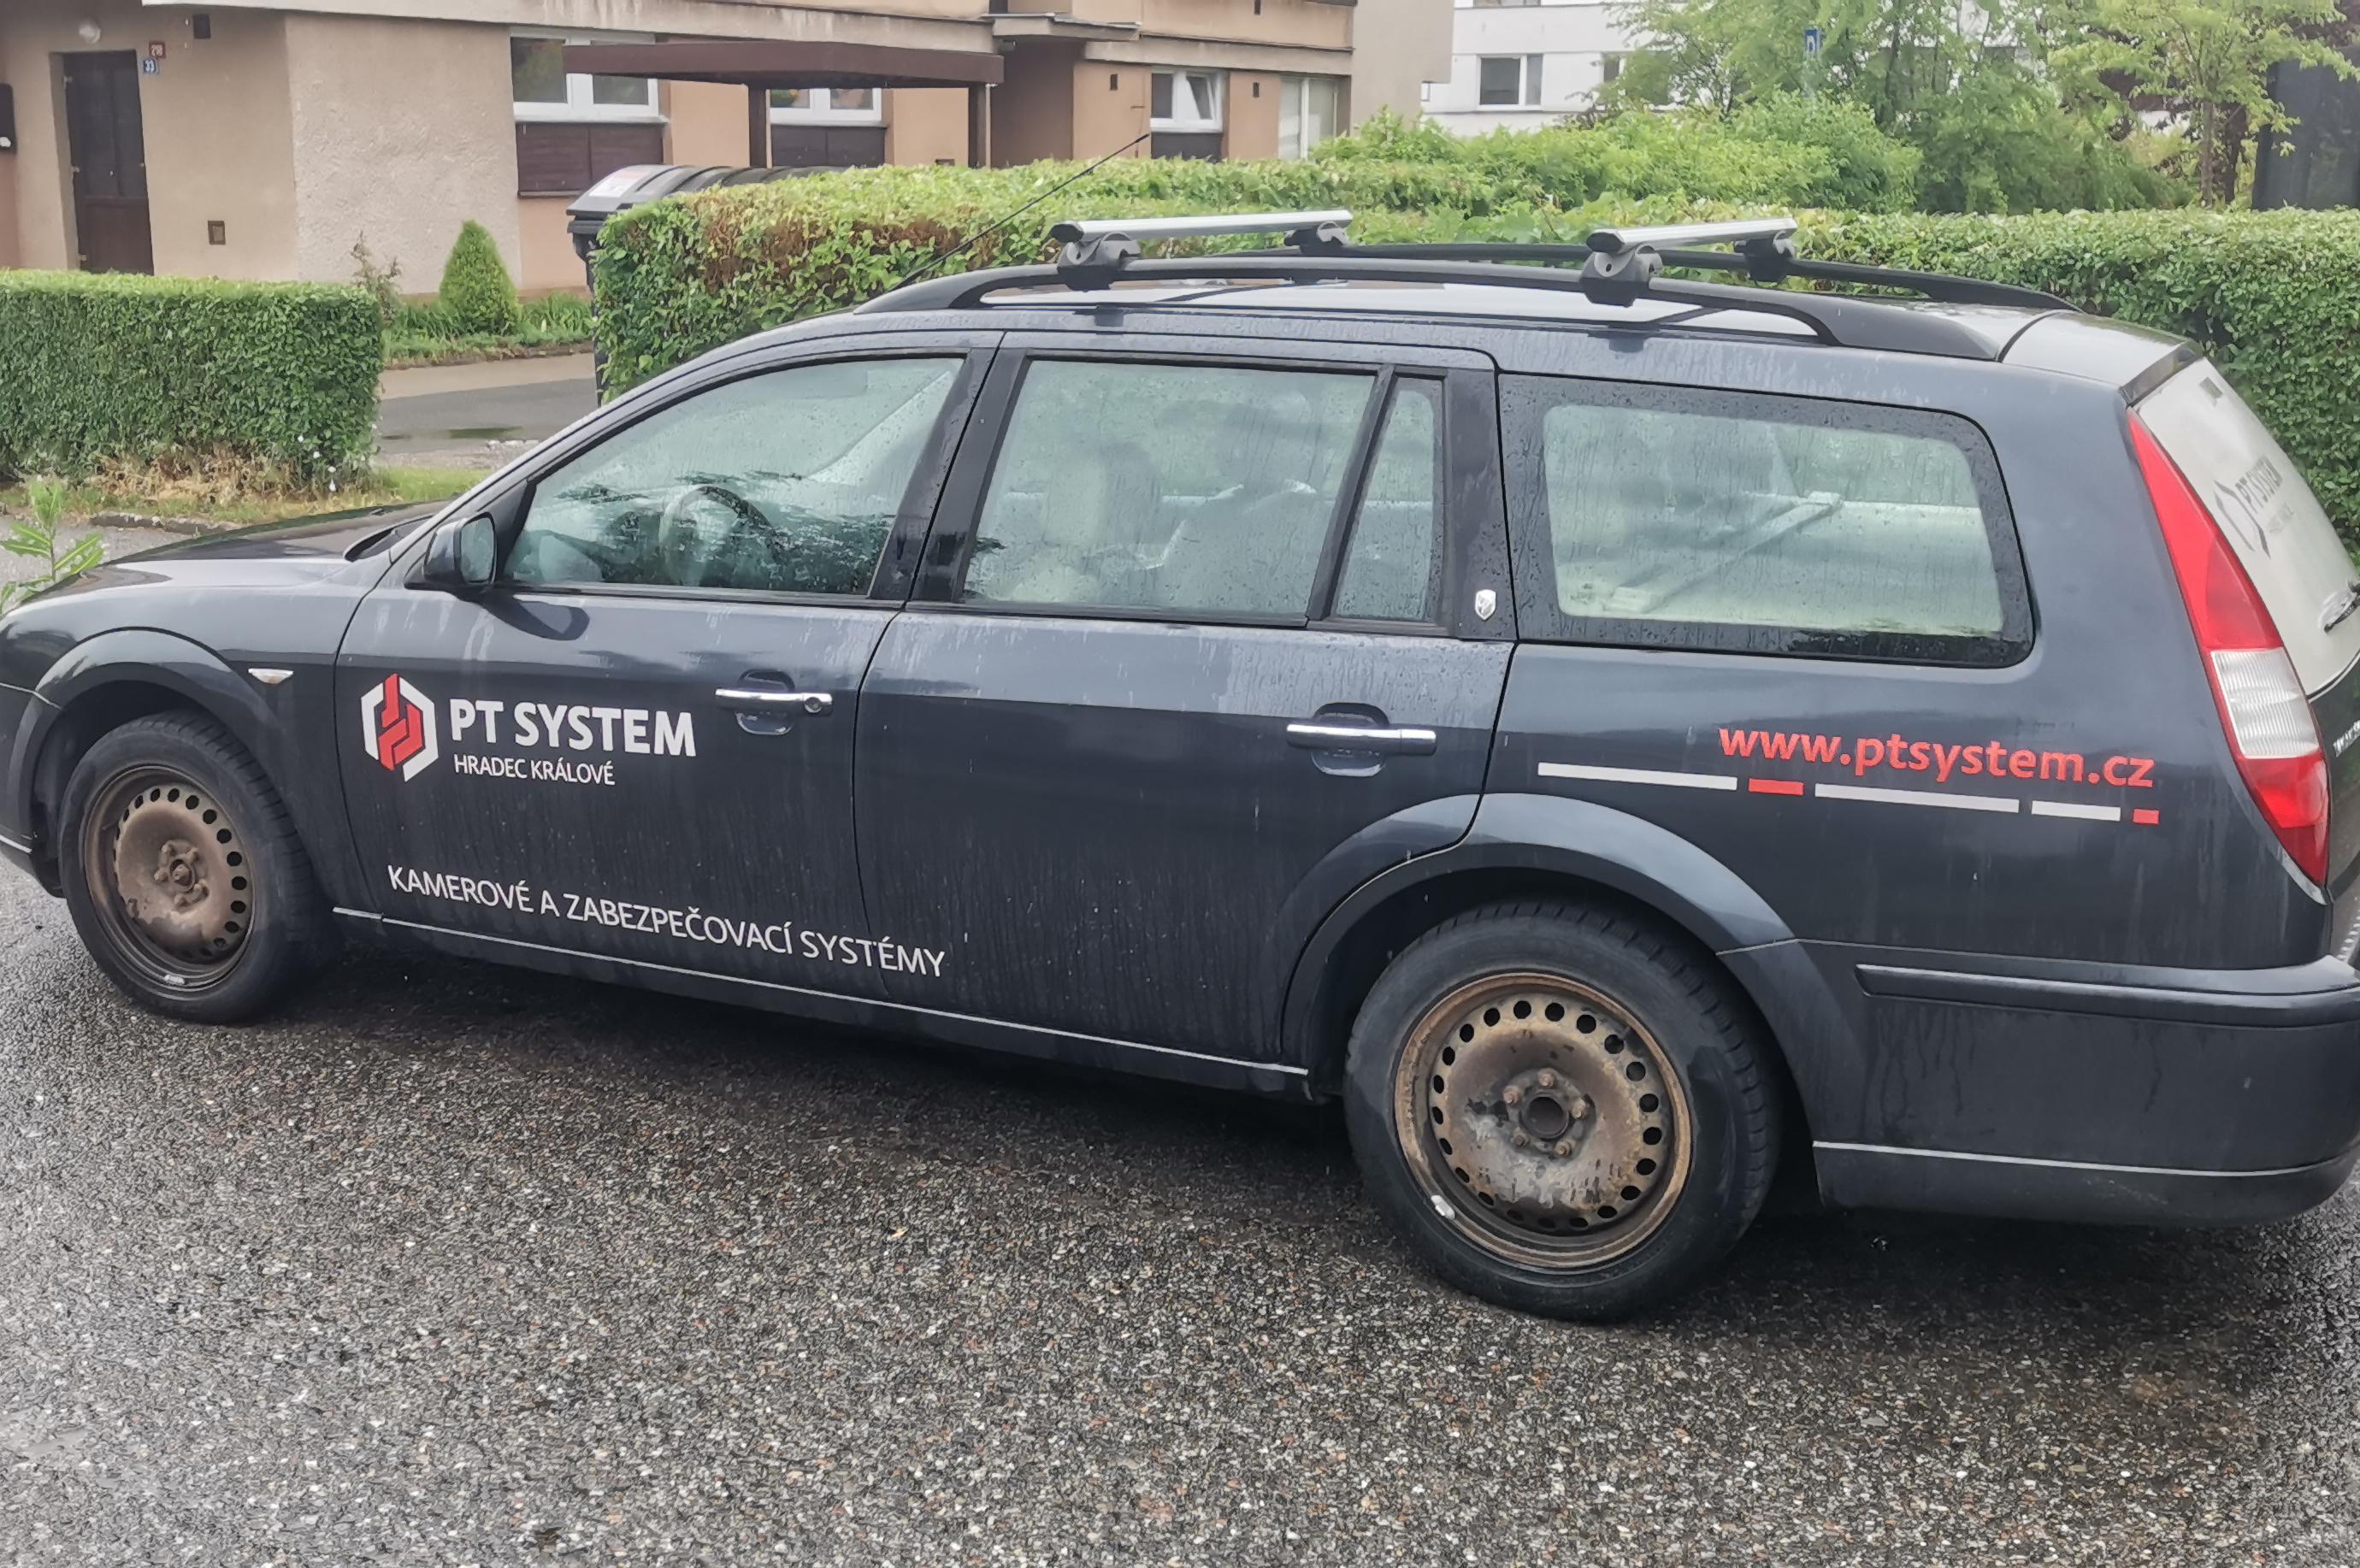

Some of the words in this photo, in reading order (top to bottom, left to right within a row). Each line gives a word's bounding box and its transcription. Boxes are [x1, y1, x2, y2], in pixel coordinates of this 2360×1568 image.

[449, 699, 504, 744] PT
[514, 702, 697, 757] SYSTEM
[453, 753, 528, 780] HRADEC
[530, 757, 616, 786] KRÁLOVÉ
[1719, 728, 2156, 788] www.ptsystem.cz
[387, 864, 534, 914] KAMEROVÉ
[540, 889, 560, 917] A
[563, 893, 793, 954] ZABEZPEČOVACÍ
[799, 930, 947, 978] SYSTÉMY
